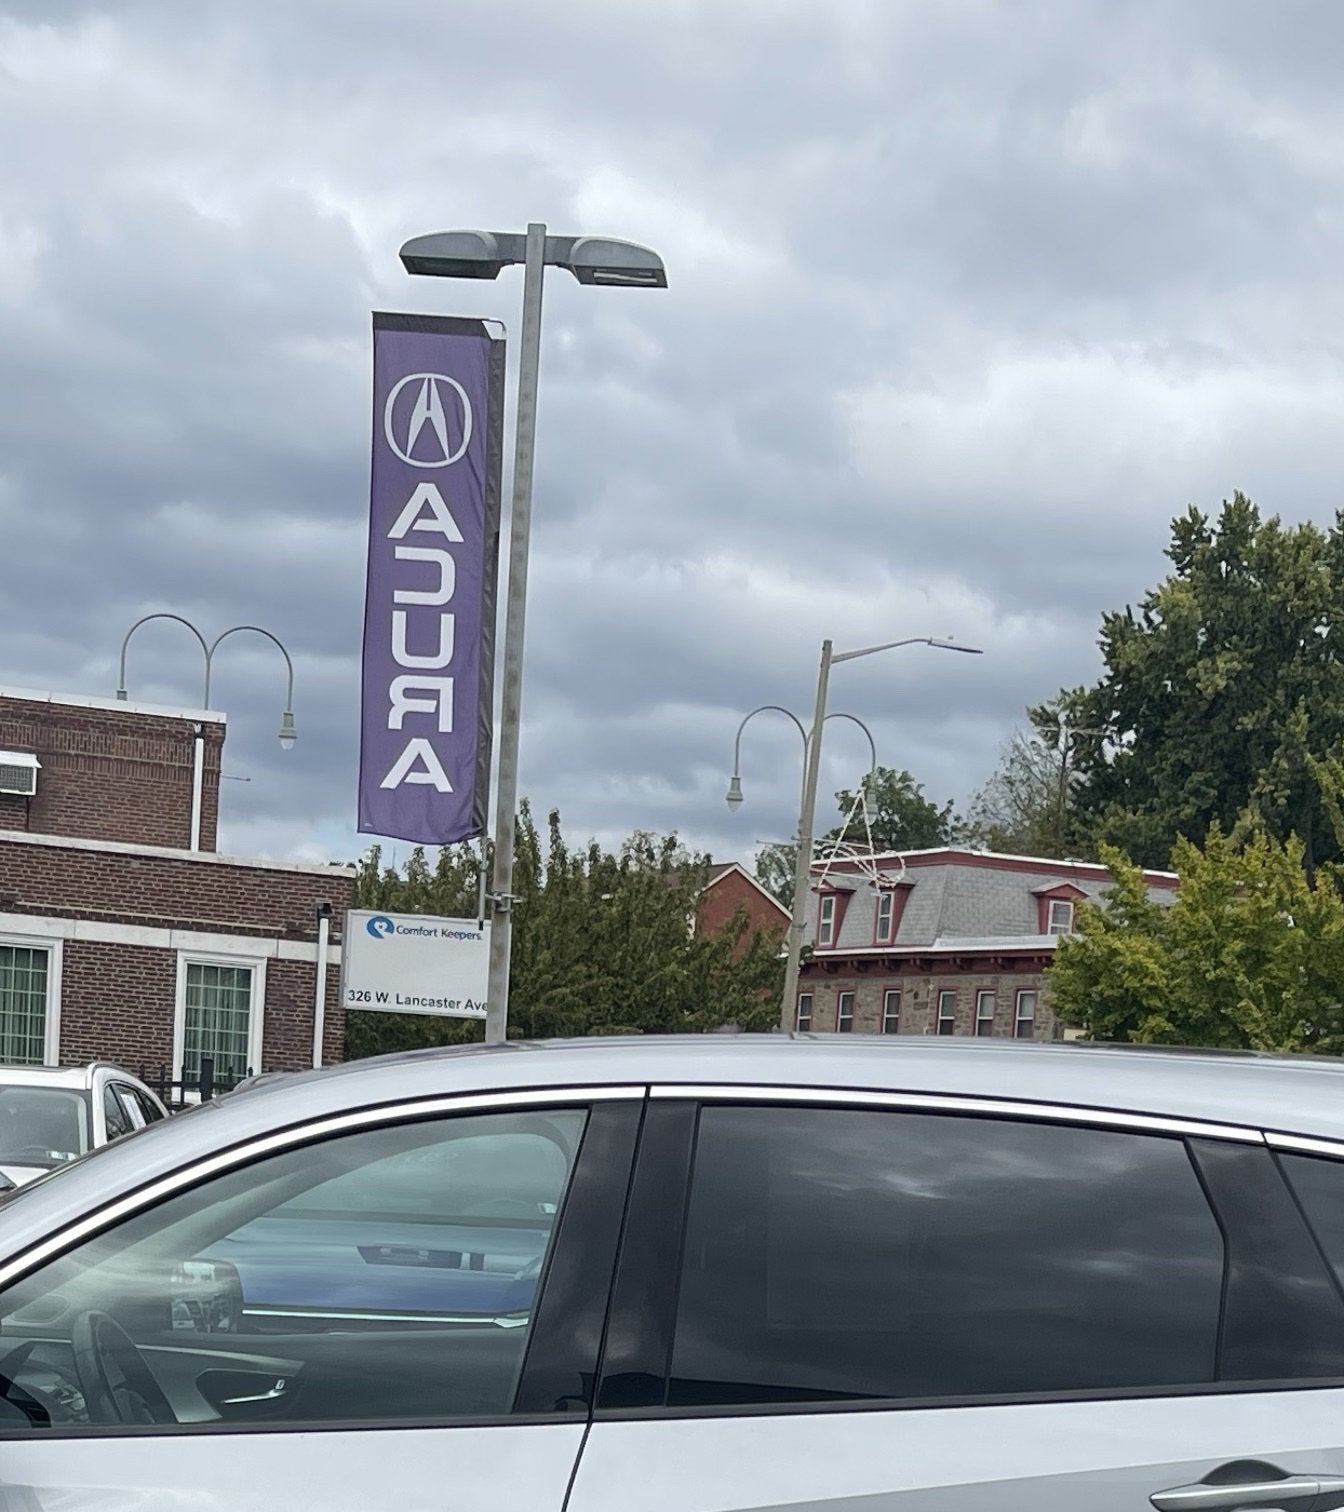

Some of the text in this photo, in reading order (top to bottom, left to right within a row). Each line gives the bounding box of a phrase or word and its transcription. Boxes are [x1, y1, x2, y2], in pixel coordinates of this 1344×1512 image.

[396, 925, 438, 937] Comfort
[348, 990, 488, 1011] 326 W. Lancaster Ave
